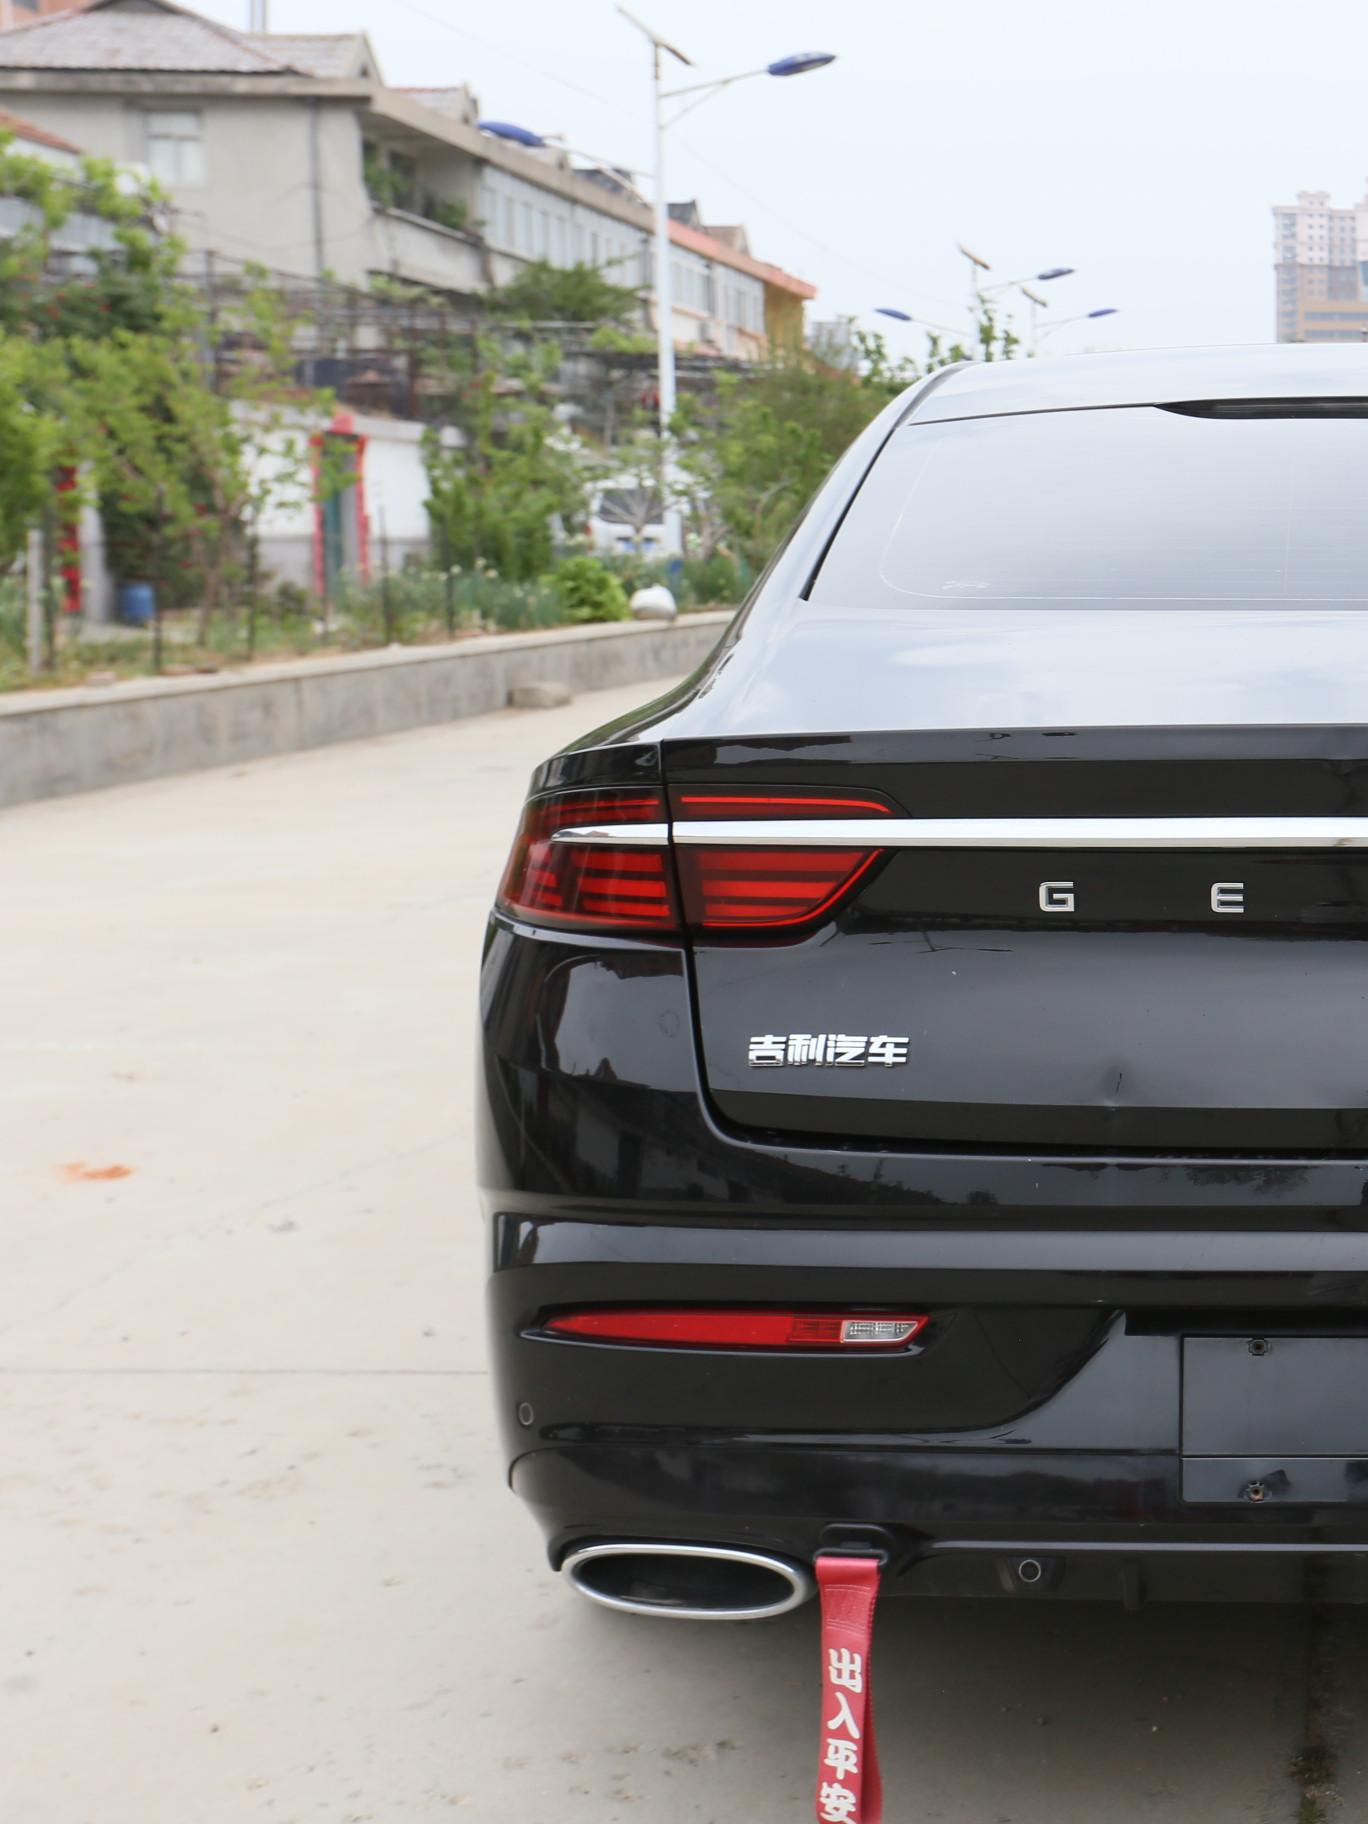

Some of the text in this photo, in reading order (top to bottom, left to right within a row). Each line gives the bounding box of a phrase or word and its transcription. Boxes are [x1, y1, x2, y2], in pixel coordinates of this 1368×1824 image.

[748, 1034, 909, 1067] 吉利汽车
[819, 1647, 864, 1824] 出入平安
